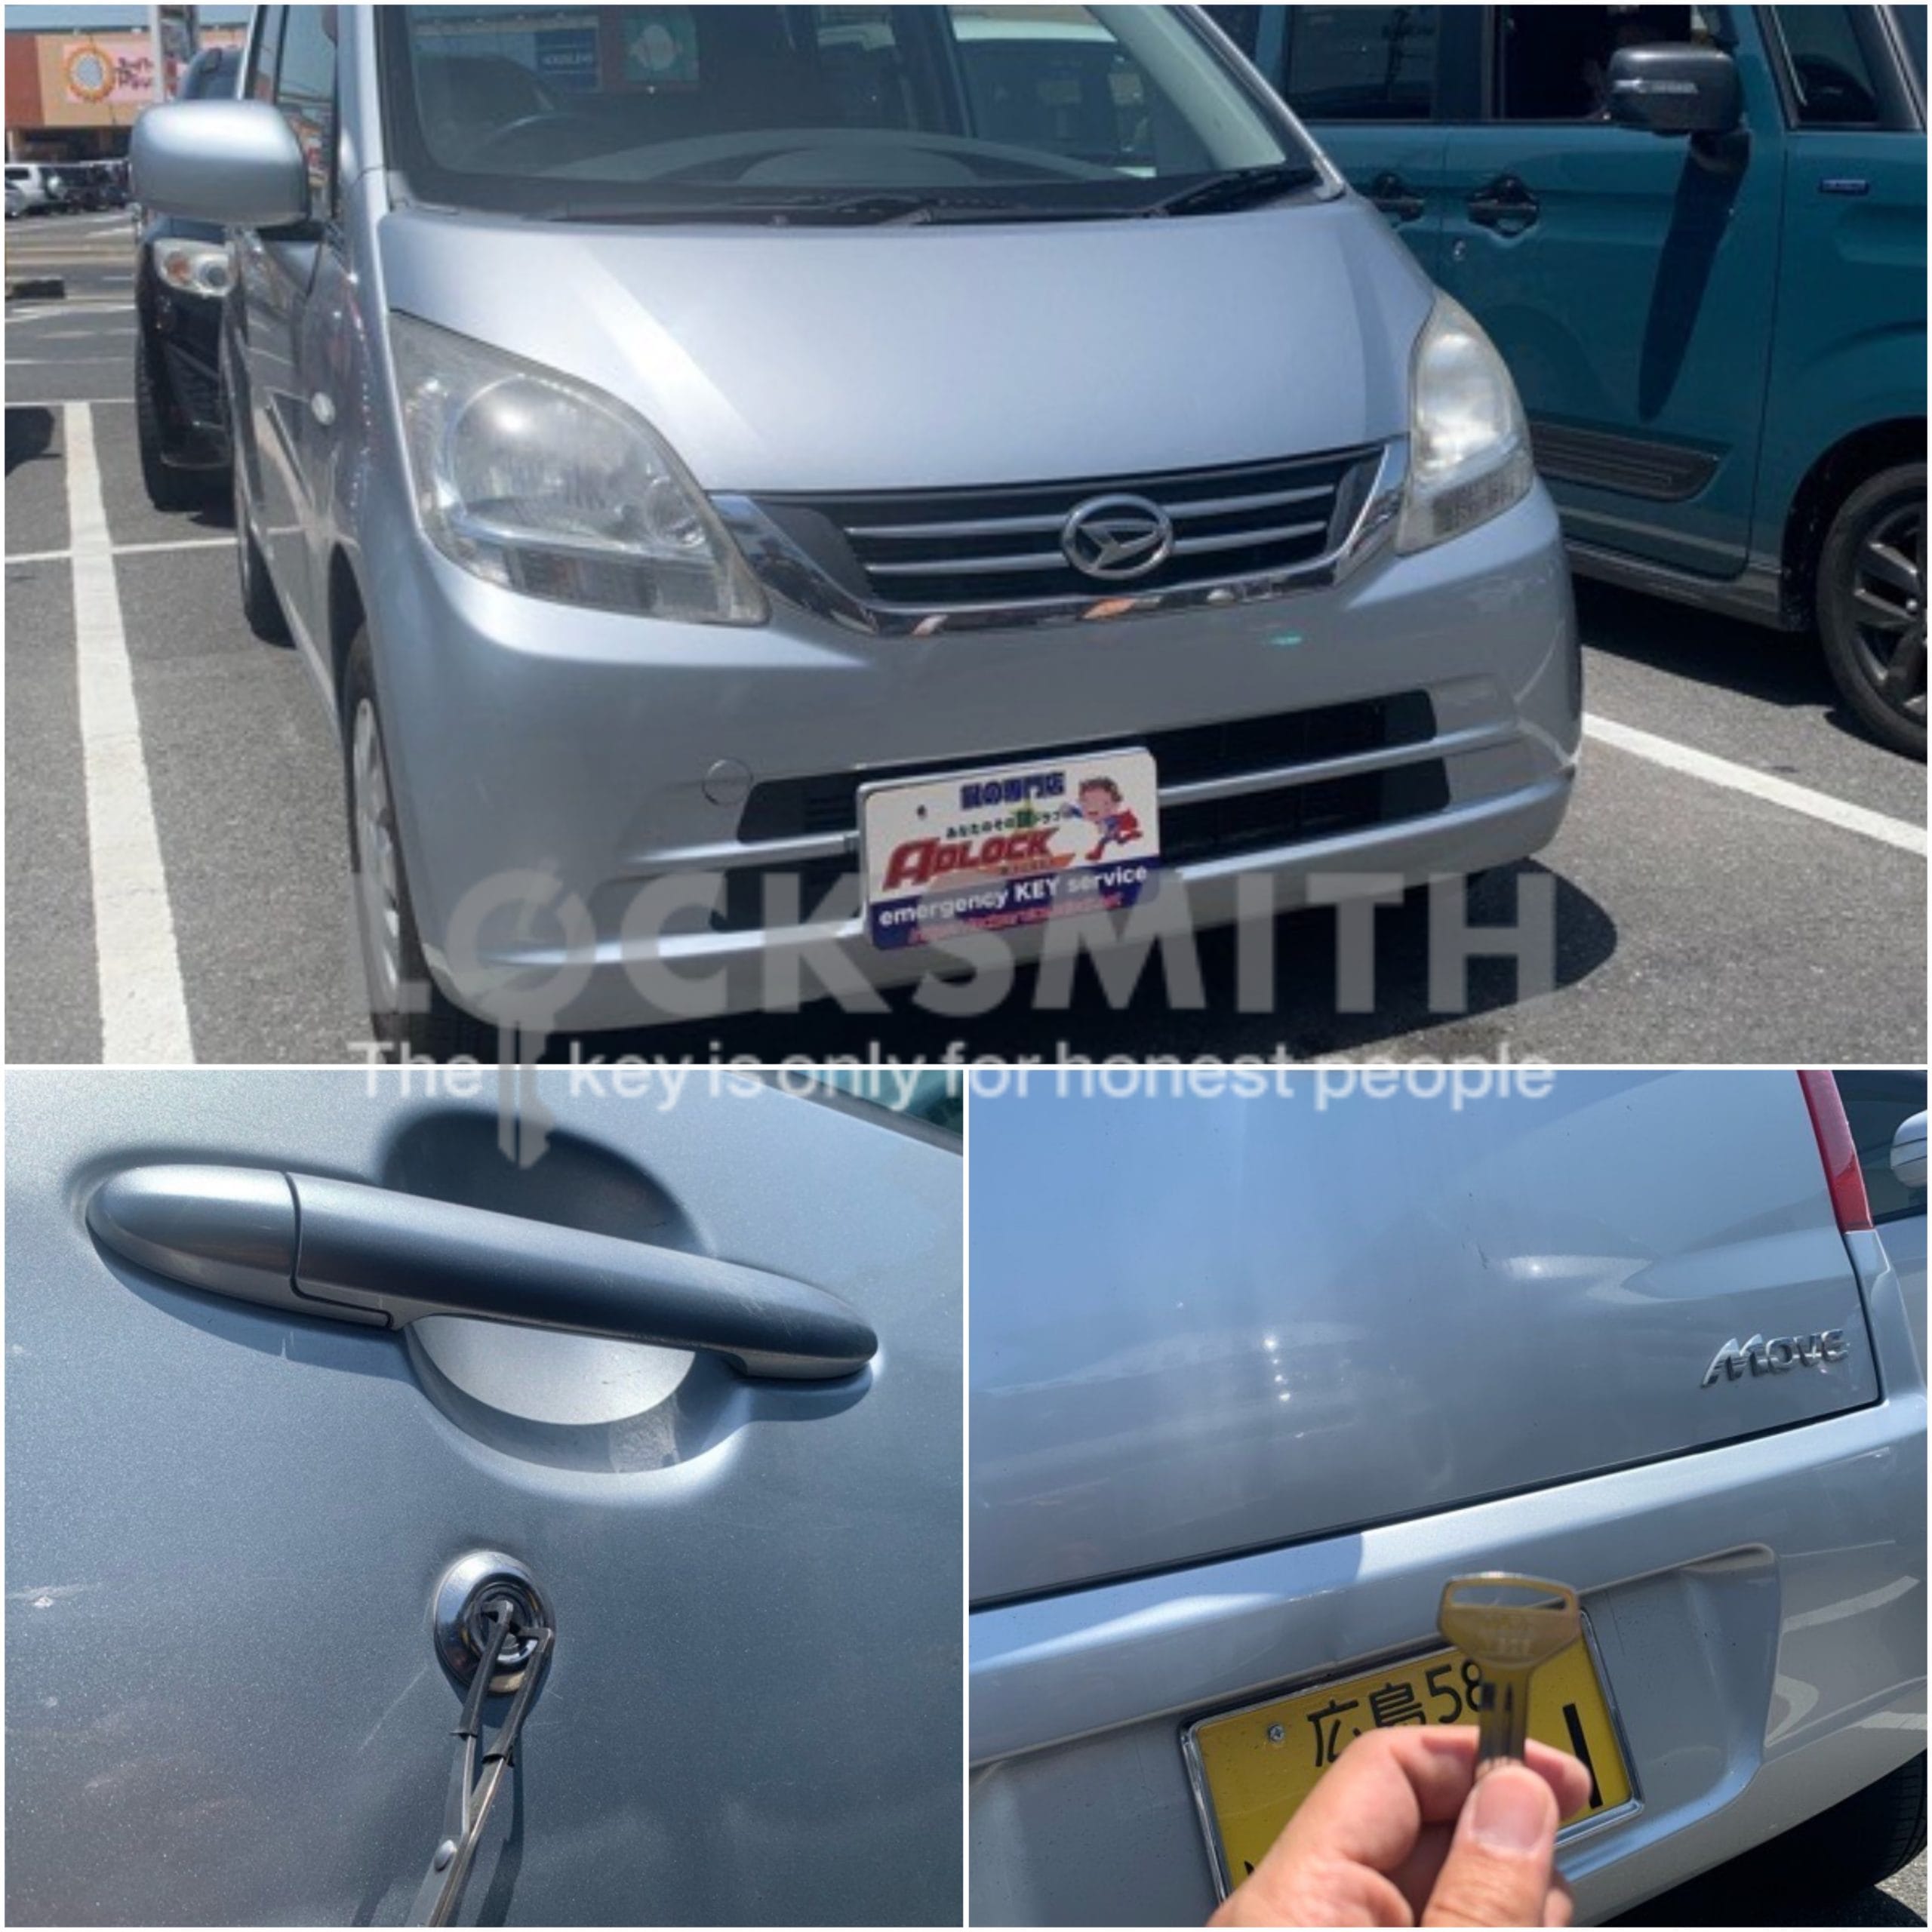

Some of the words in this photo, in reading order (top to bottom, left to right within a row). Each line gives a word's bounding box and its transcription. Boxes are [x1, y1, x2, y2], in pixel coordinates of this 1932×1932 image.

[878, 889, 1009, 928] emergency
[1014, 876, 1060, 903] KEY
[1066, 864, 1148, 894] service
